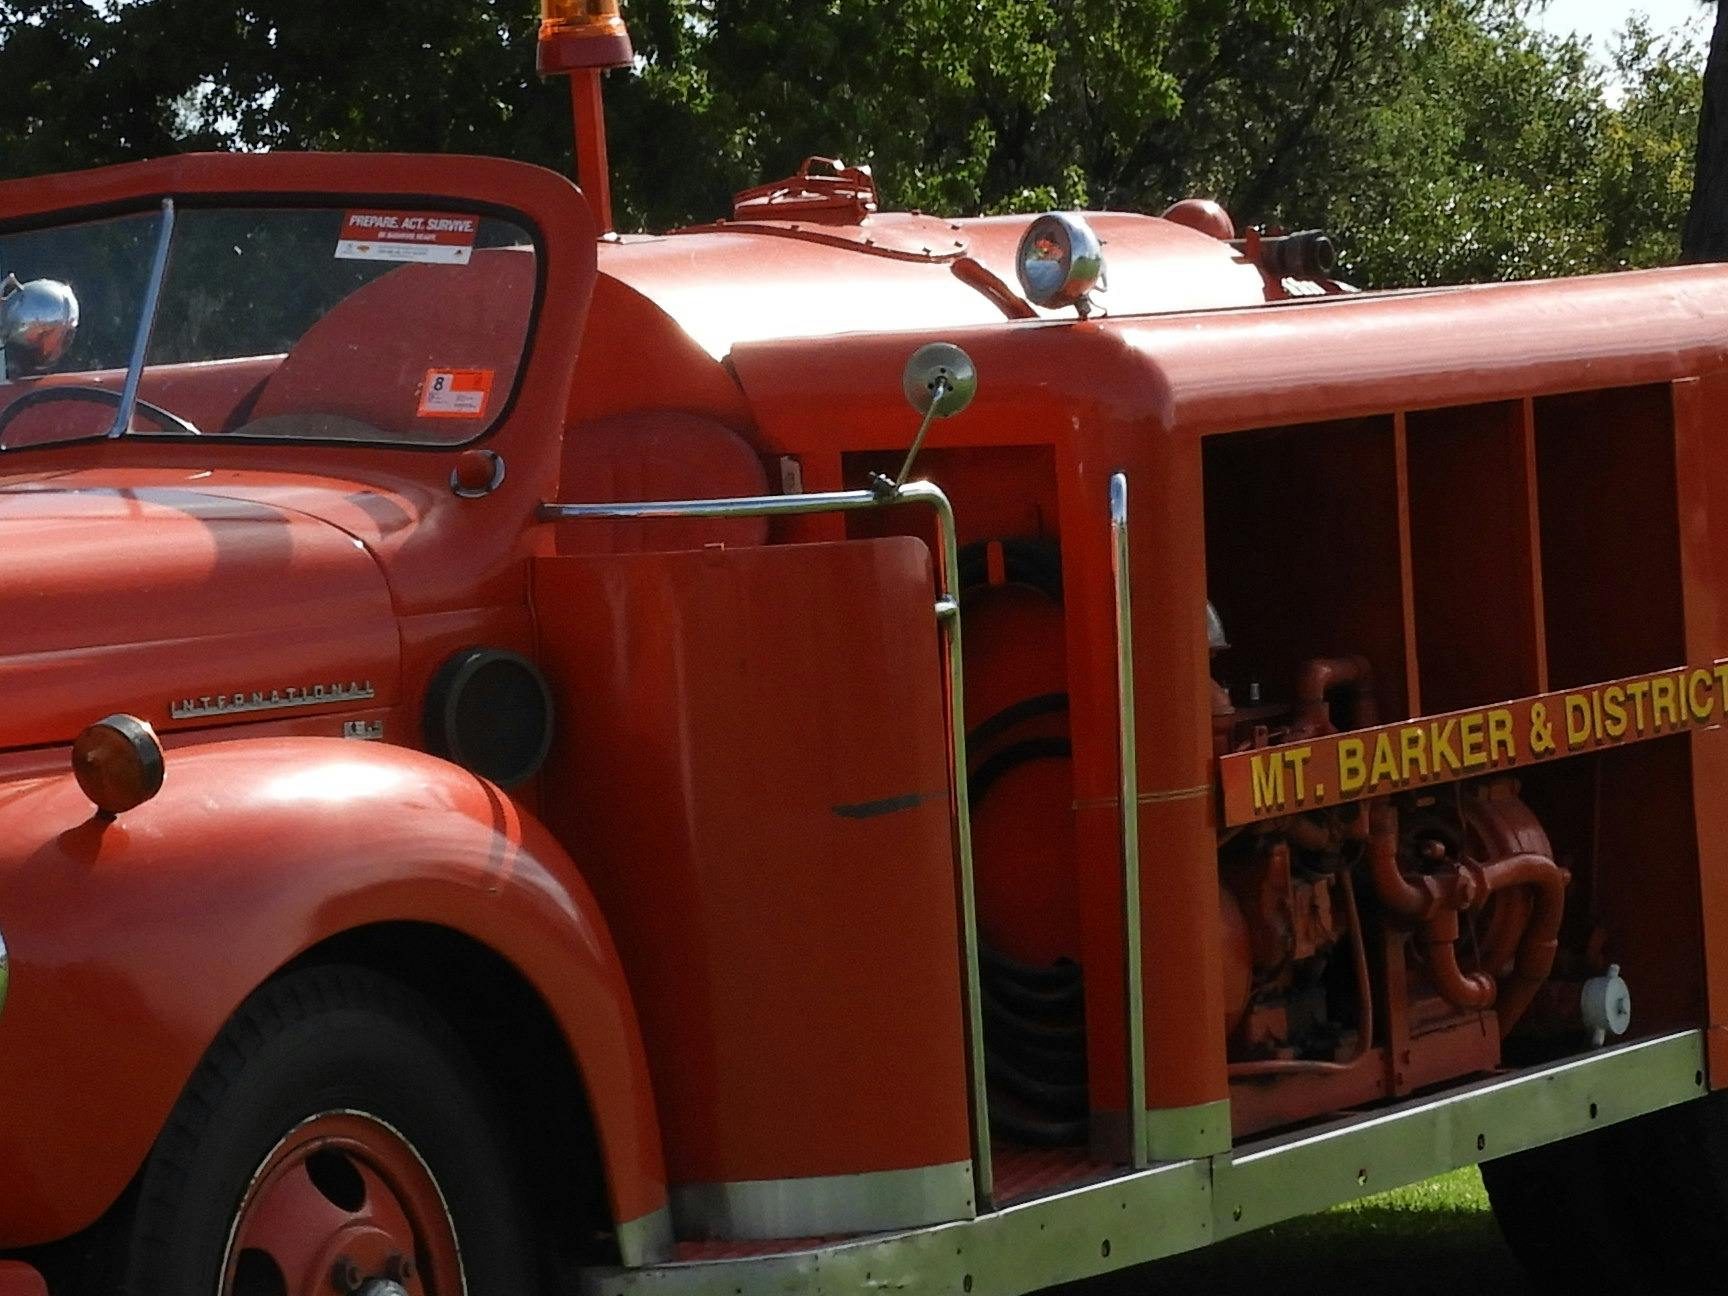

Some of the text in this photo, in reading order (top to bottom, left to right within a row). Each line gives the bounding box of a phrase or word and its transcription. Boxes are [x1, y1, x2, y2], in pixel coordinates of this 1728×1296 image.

[349, 215, 474, 232] PREPARE. ACT. SURVIVE.
[434, 377, 445, 391] 8
[171, 680, 374, 717] INTERNATIONAL
[1250, 746, 1325, 810] MT.
[1337, 707, 1517, 793] BARKER
[1530, 702, 1555, 752] &
